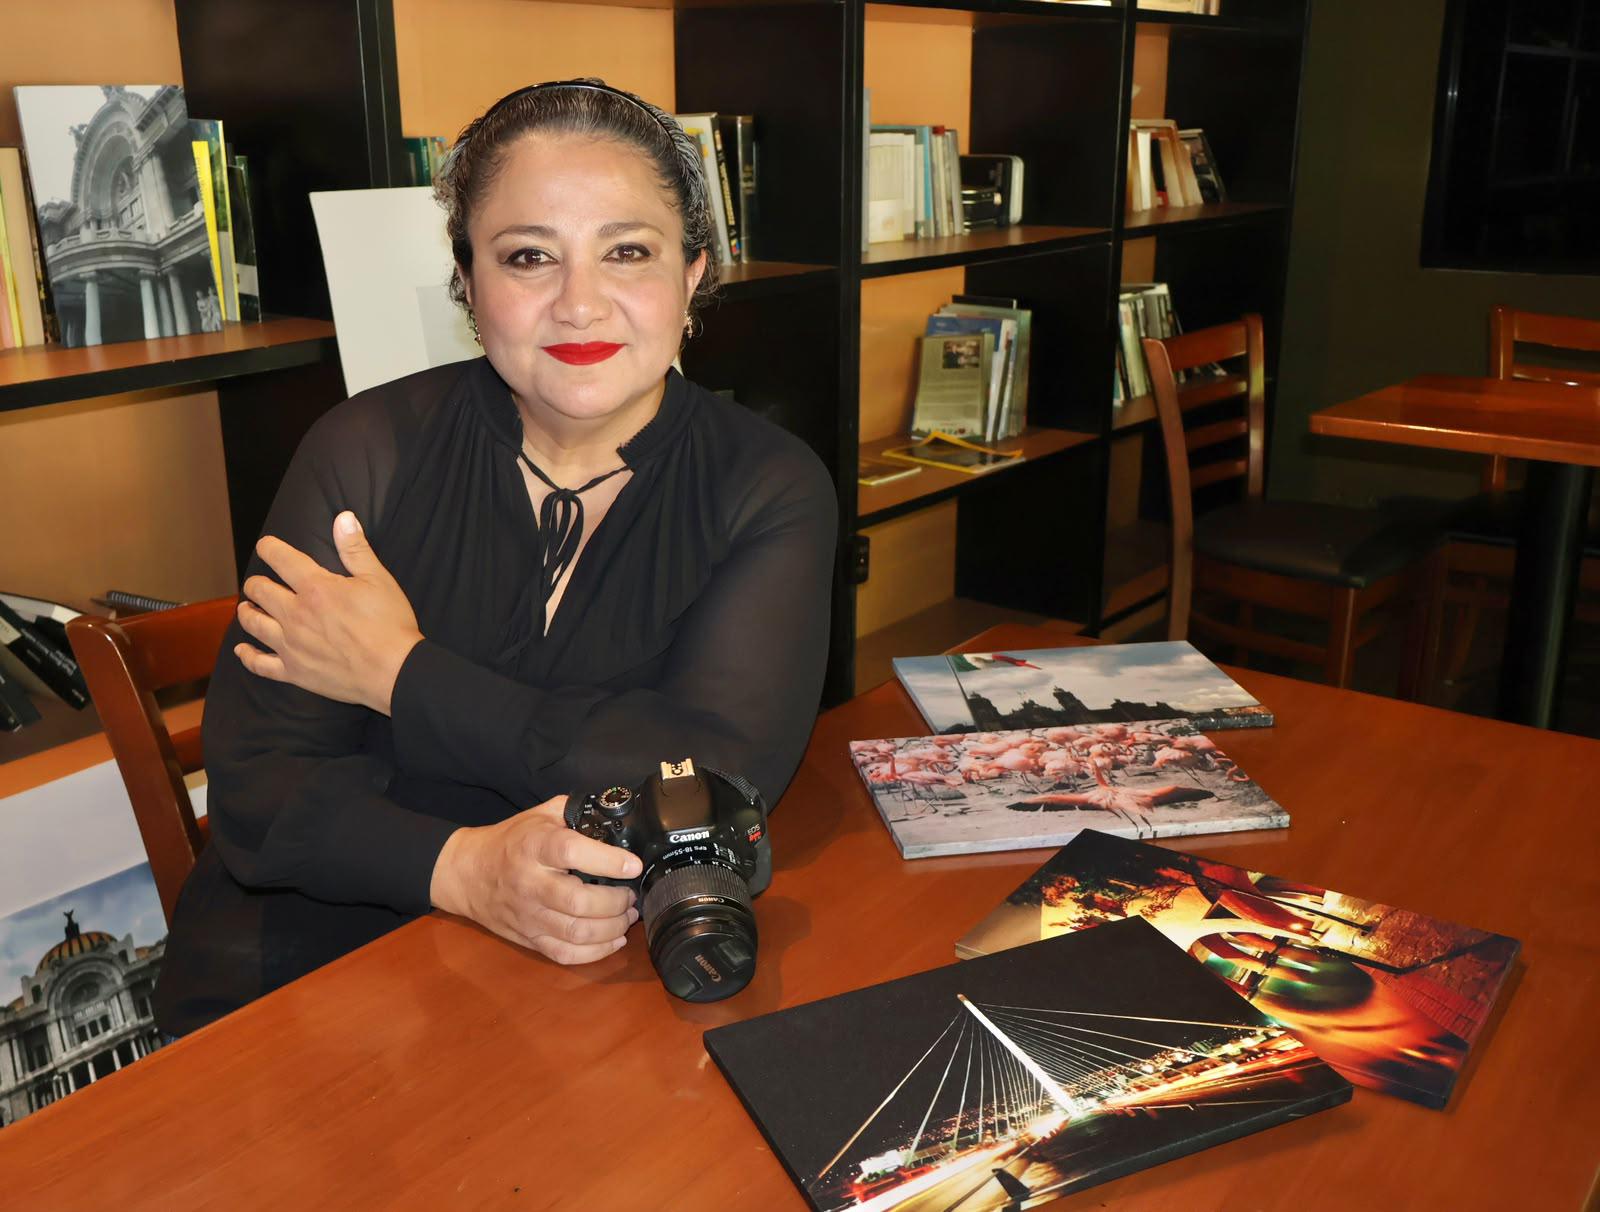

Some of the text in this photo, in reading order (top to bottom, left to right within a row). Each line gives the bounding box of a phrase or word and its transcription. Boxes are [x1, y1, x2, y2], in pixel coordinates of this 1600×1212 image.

[747, 823, 760, 835] EOS
[669, 830, 710, 843] Canon
[694, 954, 721, 982] Canon
